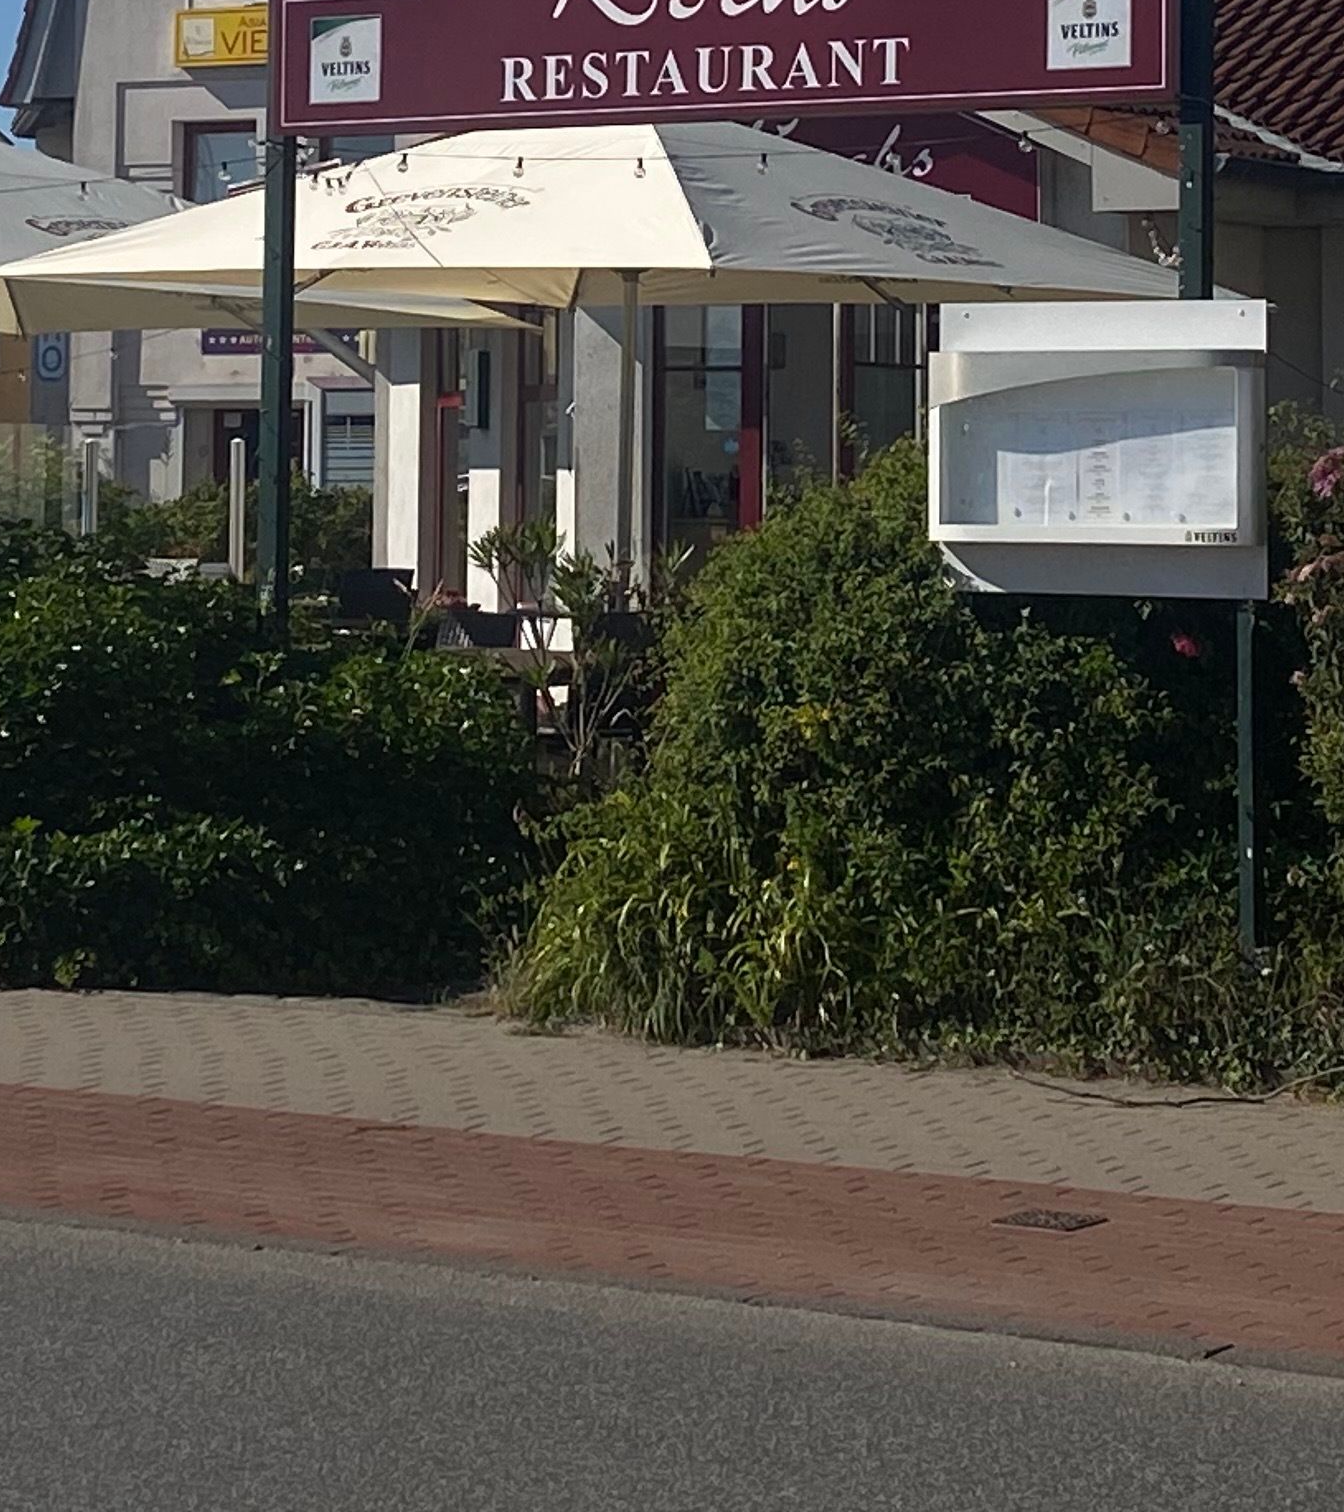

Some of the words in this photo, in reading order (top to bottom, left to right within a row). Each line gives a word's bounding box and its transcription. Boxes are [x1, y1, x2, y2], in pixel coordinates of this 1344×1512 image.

[1061, 21, 1120, 40] VELTINS
[321, 60, 371, 77] VELTINS
[500, 37, 911, 103] RESTAURANT
